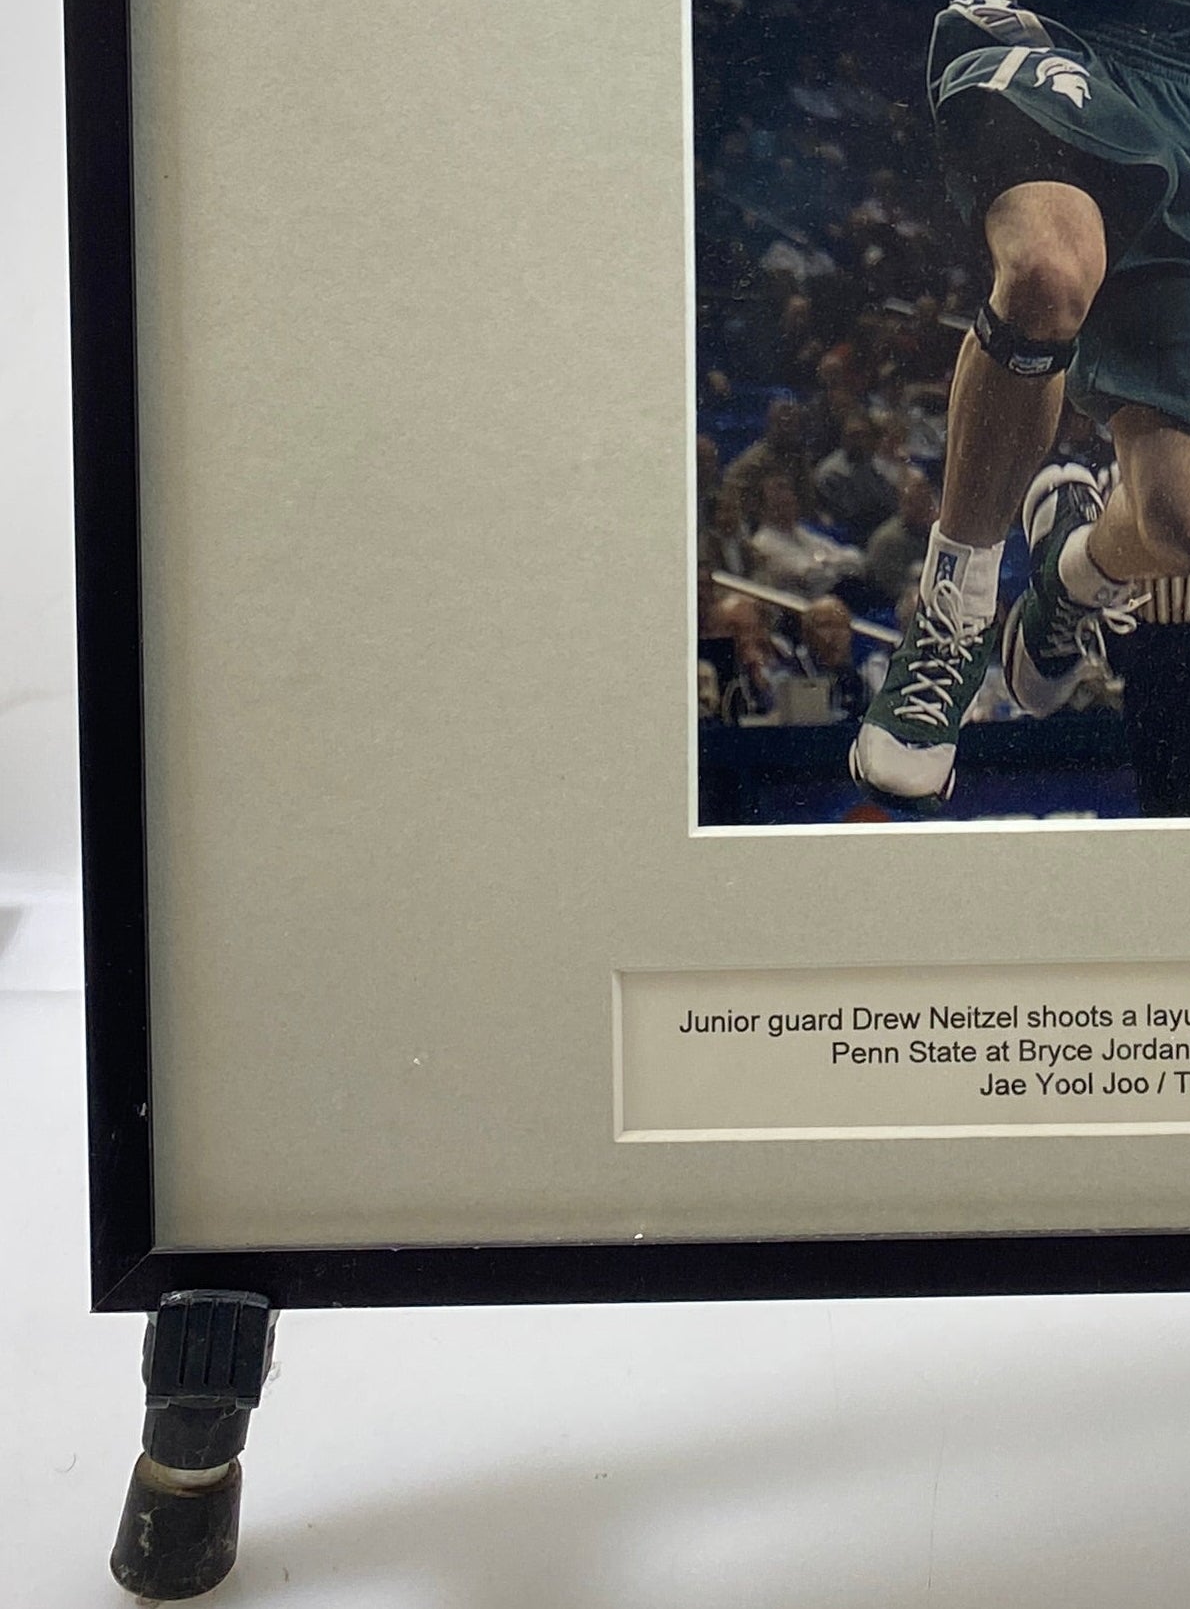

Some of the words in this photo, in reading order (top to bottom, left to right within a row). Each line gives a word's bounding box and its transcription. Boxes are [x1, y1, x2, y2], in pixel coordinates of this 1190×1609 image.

[678, 1009, 761, 1034] Junior
[767, 1007, 843, 1038] guard
[852, 1006, 922, 1031] Drew
[929, 1004, 1018, 1030] Neitzel
[1026, 1004, 1114, 1029] shoots
[1121, 1009, 1138, 1027] a
[831, 1041, 900, 1065] Penn
[908, 1039, 977, 1064] State
[985, 1040, 1011, 1063] at
[1018, 1038, 1093, 1068] Bryce
[1101, 1036, 1190, 1061] Jordan
[979, 1072, 1027, 1097] Jae
[1035, 1071, 1094, 1096] Yool
[1102, 1071, 1150, 1095] Joo
[1156, 1070, 1167, 1095] /
